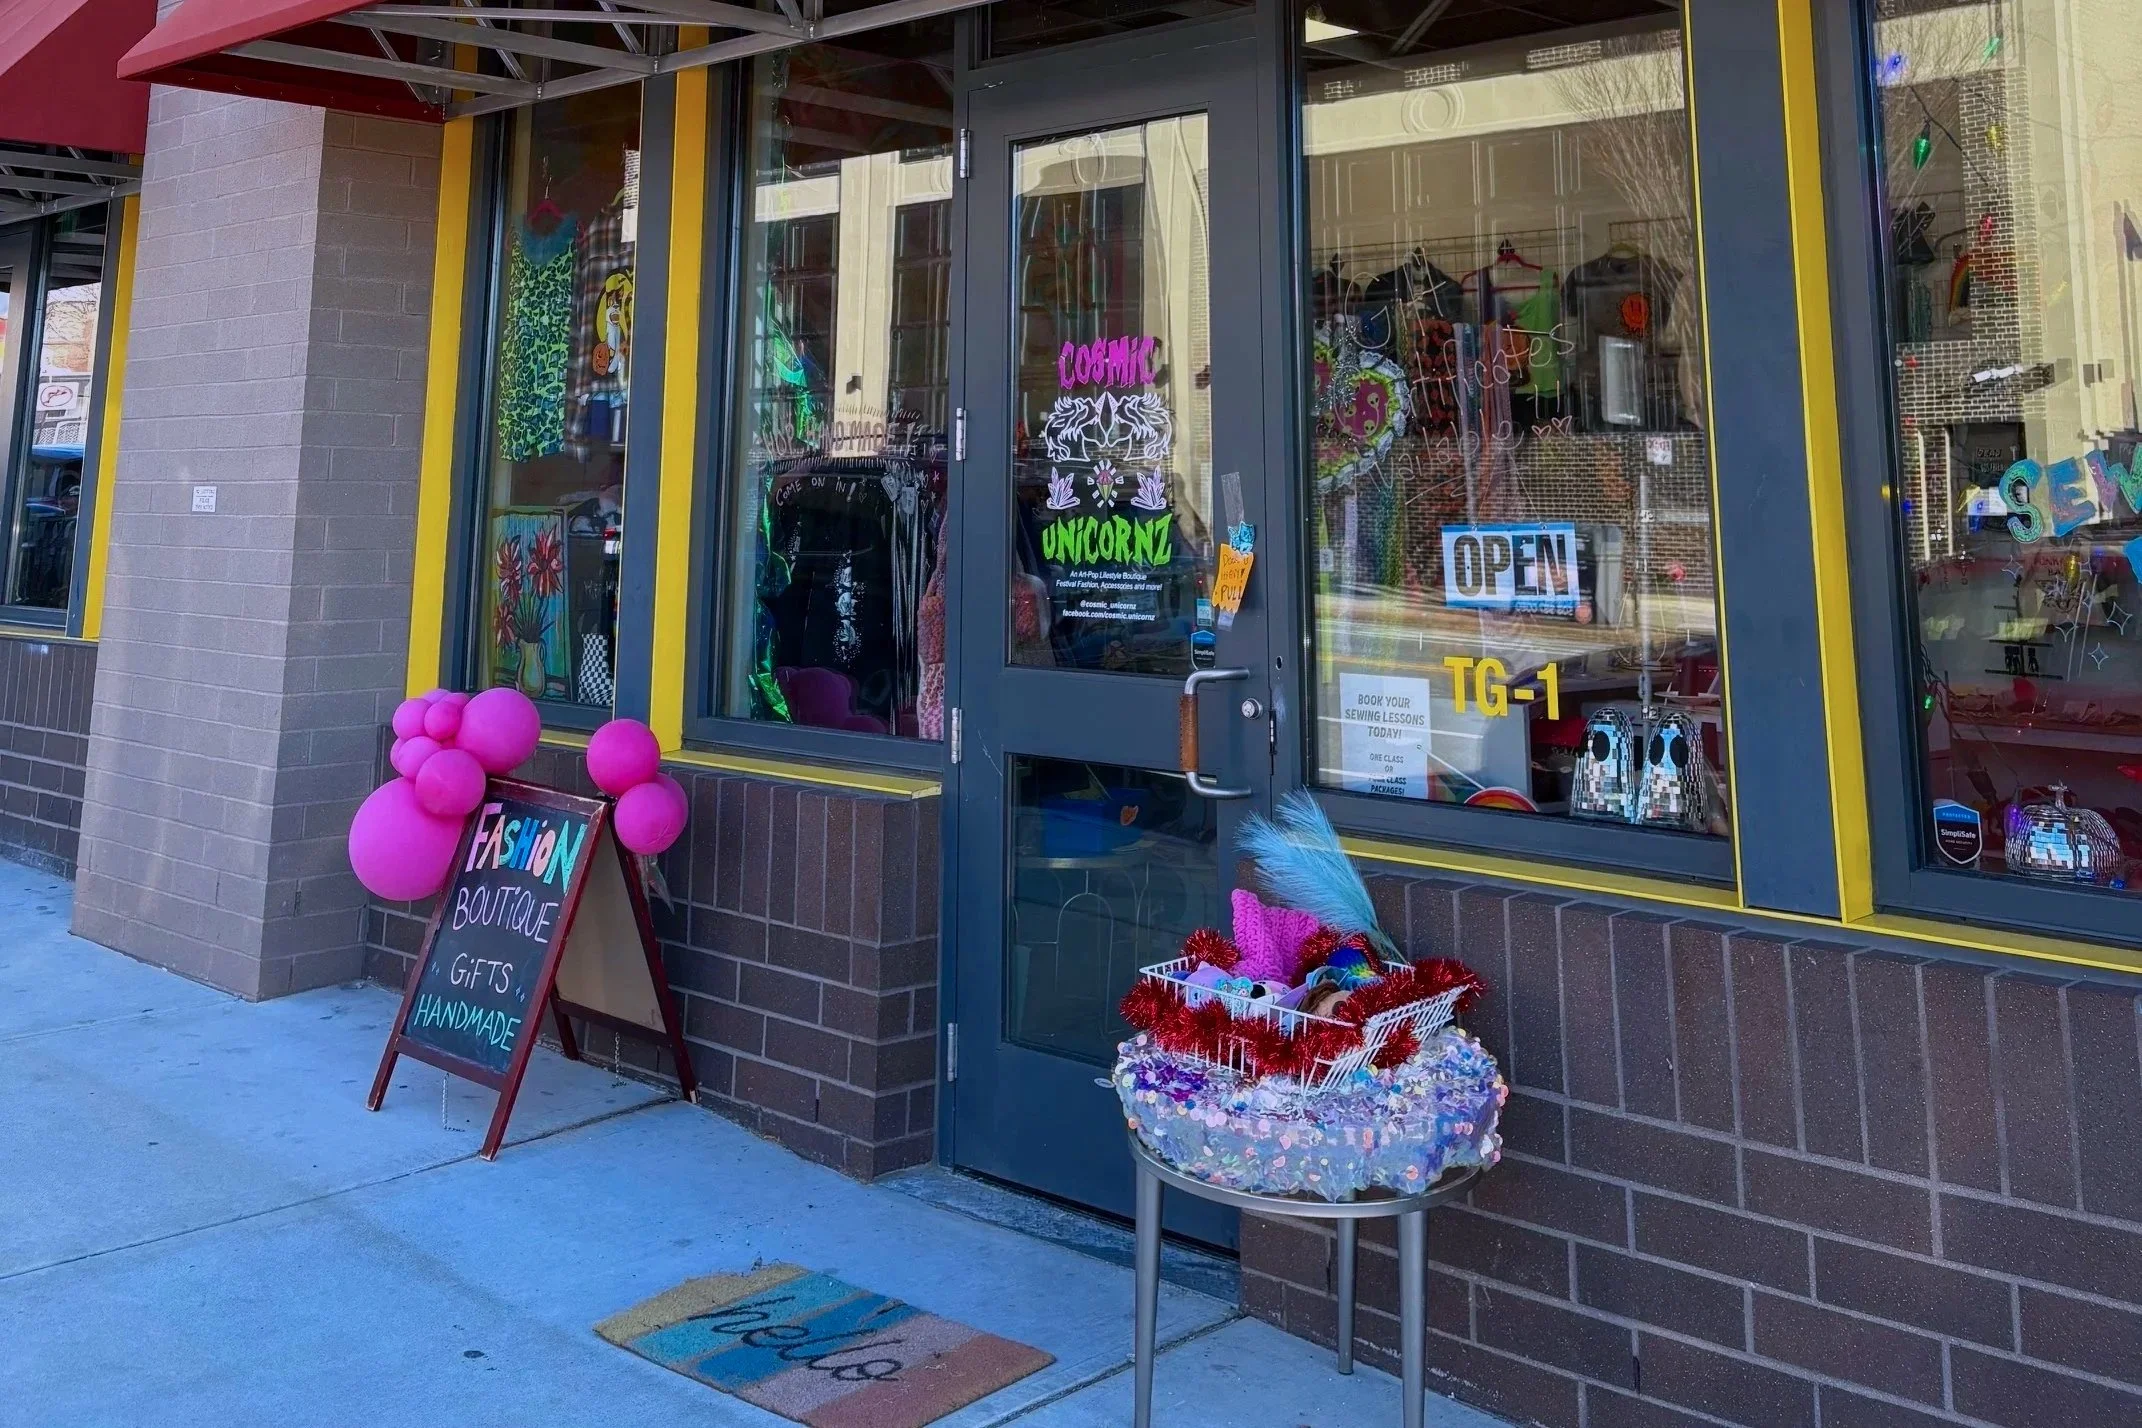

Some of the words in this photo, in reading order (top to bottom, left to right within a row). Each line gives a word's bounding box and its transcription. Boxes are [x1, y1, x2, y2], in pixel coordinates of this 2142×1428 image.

[811, 477, 826, 487] ON
[1454, 533, 1569, 597] OPEN
[1078, 571, 1098, 580] Art-Pop
[1099, 571, 1122, 581] Lifestyle
[1122, 572, 1147, 581] Boutique
[1056, 580, 1076, 588] Festival
[1100, 581, 1133, 590] Accessories
[1146, 583, 1162, 591] more!
[1080, 600, 1137, 610] @cosmic_unicornz
[1062, 609, 1156, 621] facebook.com/cosmic.unicornz
[1443, 656, 1560, 721] TG-1
[1358, 694, 1384, 707] BOOK
[1385, 696, 1411, 709] YOUR
[1344, 709, 1381, 722] SEWING
[1383, 711, 1425, 726] LESSONS
[1367, 726, 1402, 739] TODAY!
[1369, 753, 1383, 762] ONE
[1383, 754, 1404, 764] CLASS
[1386, 776, 1407, 785] CLASS
[1370, 784, 1405, 796] PACKAGES!
[1940, 828, 1976, 839] SimpliSafe
[413, 993, 522, 1052] HANDMADE
[687, 1296, 903, 1382] hello
